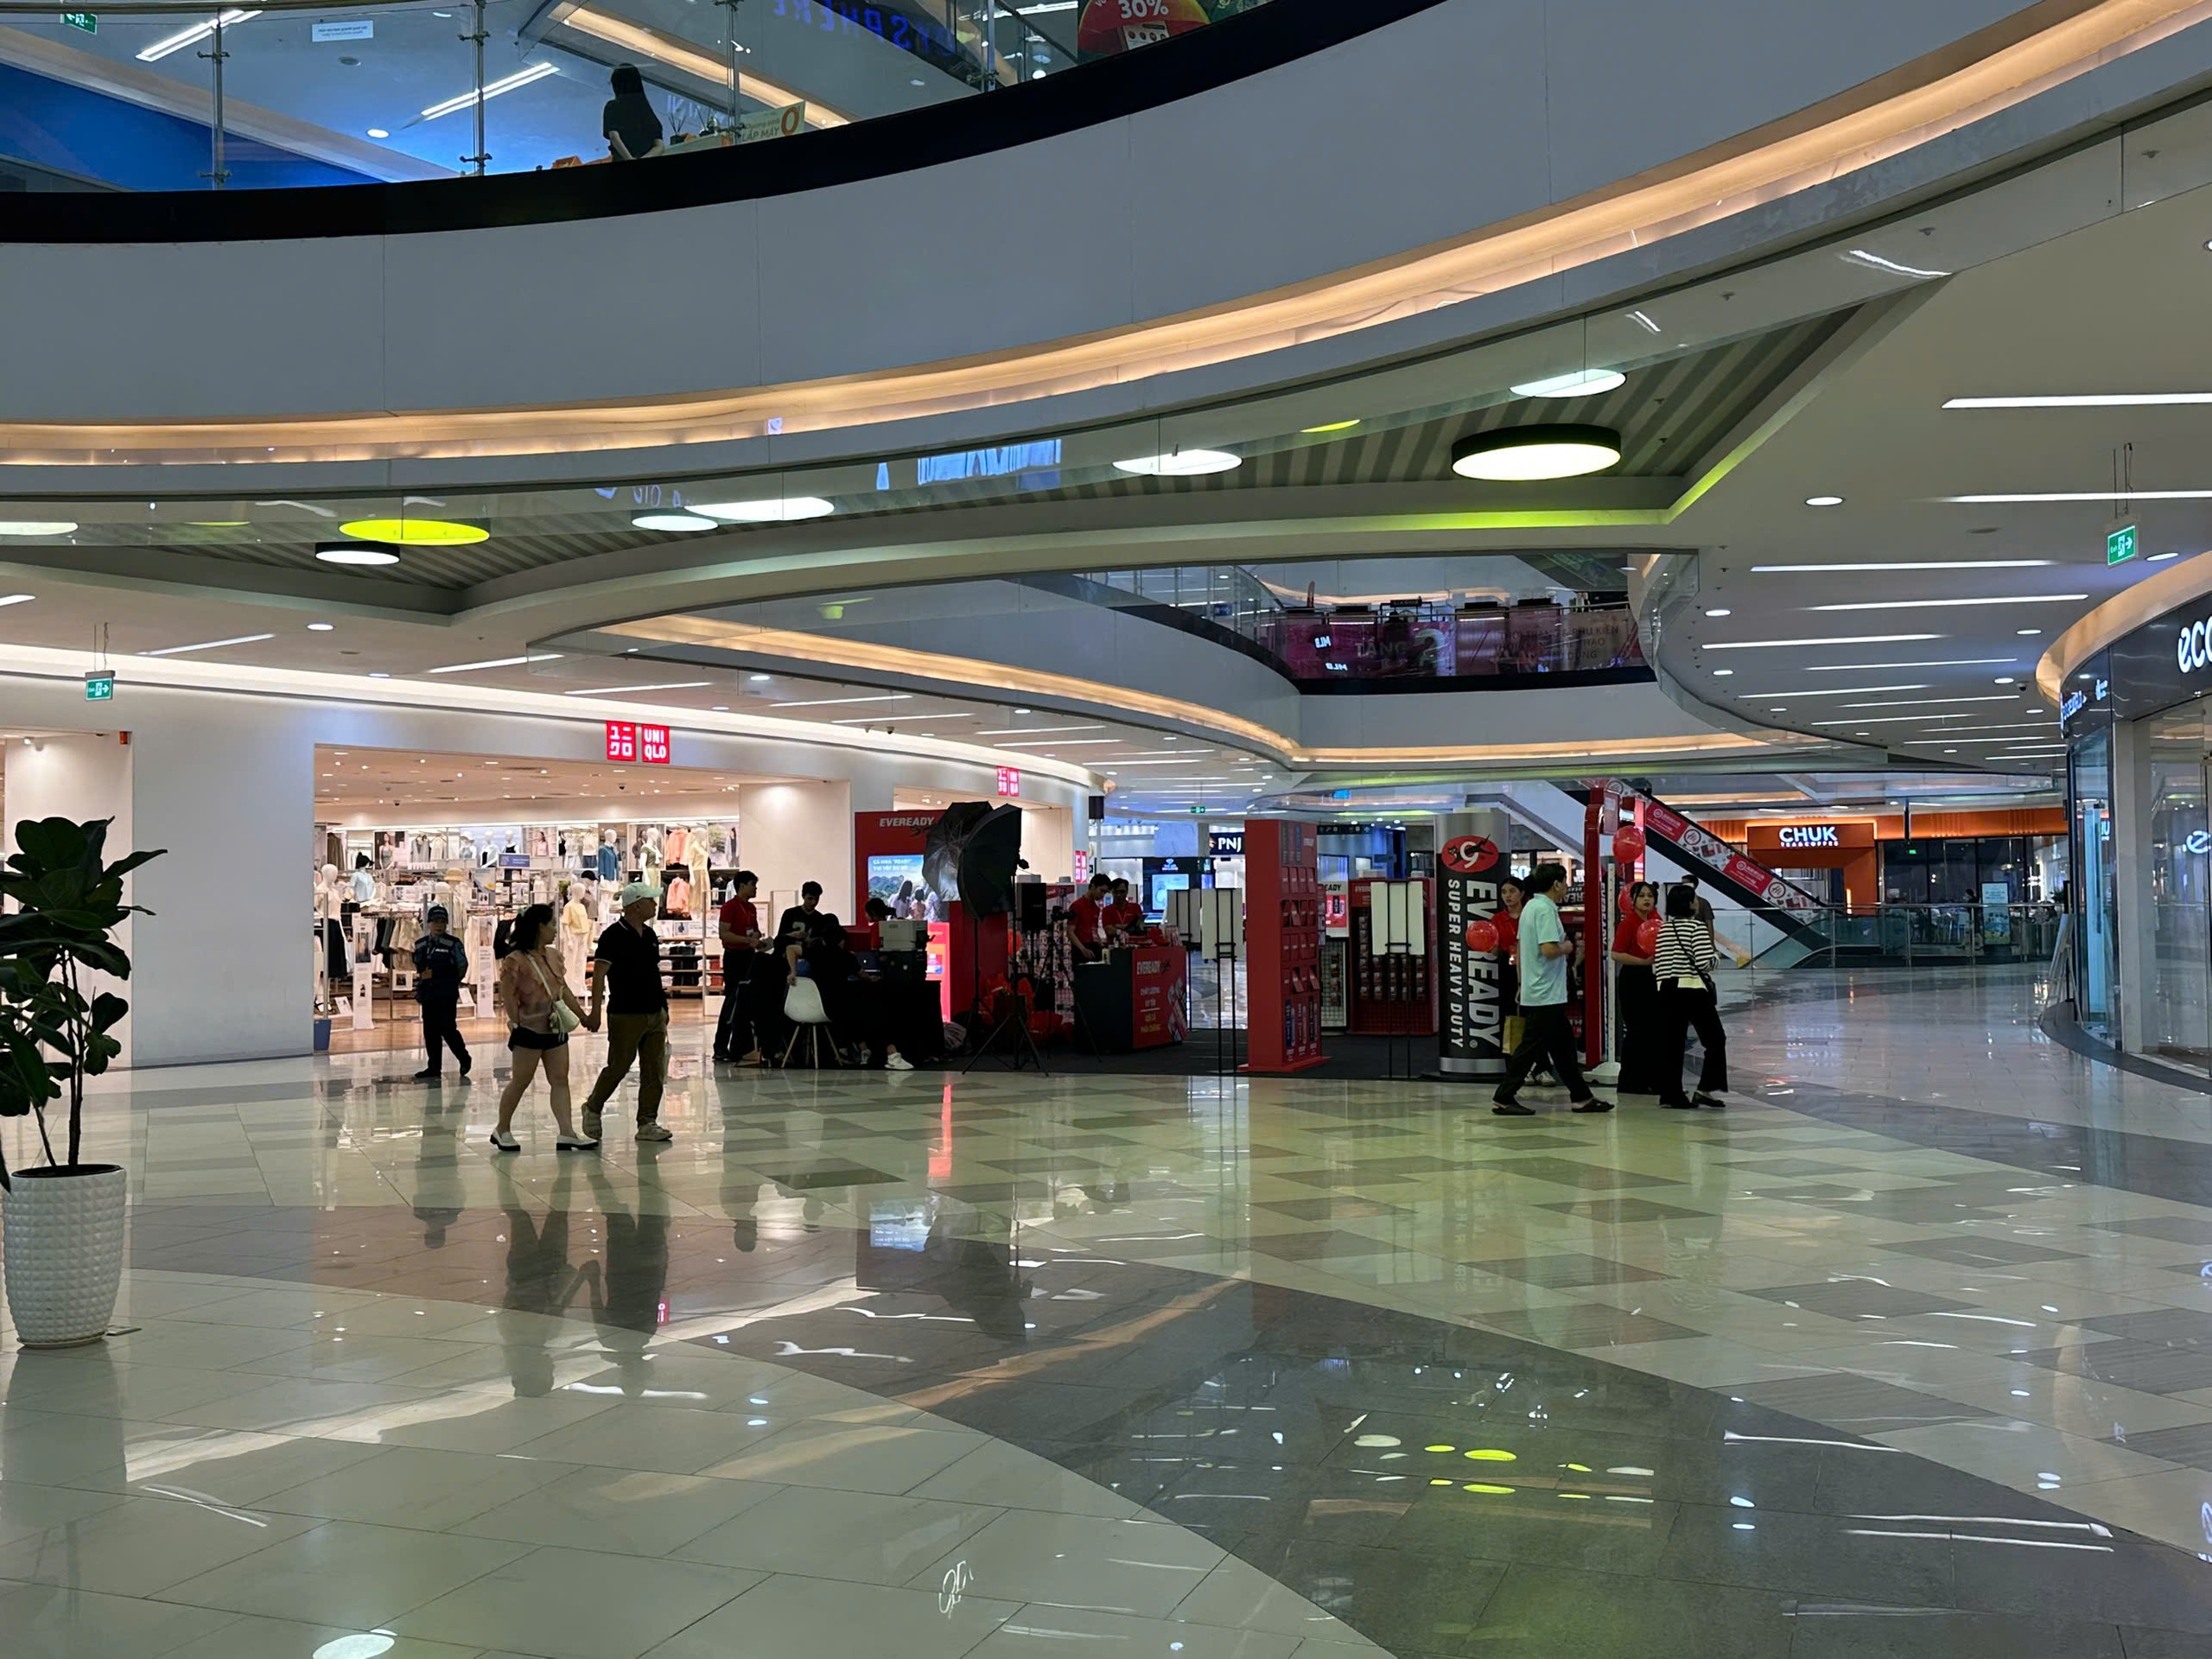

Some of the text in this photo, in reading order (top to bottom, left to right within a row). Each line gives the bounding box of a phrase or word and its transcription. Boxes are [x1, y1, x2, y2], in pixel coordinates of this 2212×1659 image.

[644, 728, 664, 743] UNI
[645, 744, 667, 760] QLO
[879, 817, 935, 827] EVEREADY
[1779, 826, 1838, 842] CHUK
[1217, 836, 1242, 853] PNJ
[1448, 879, 1464, 1048] SUPER HEAVY DUTY
[1466, 880, 1501, 1048] EVREADY
